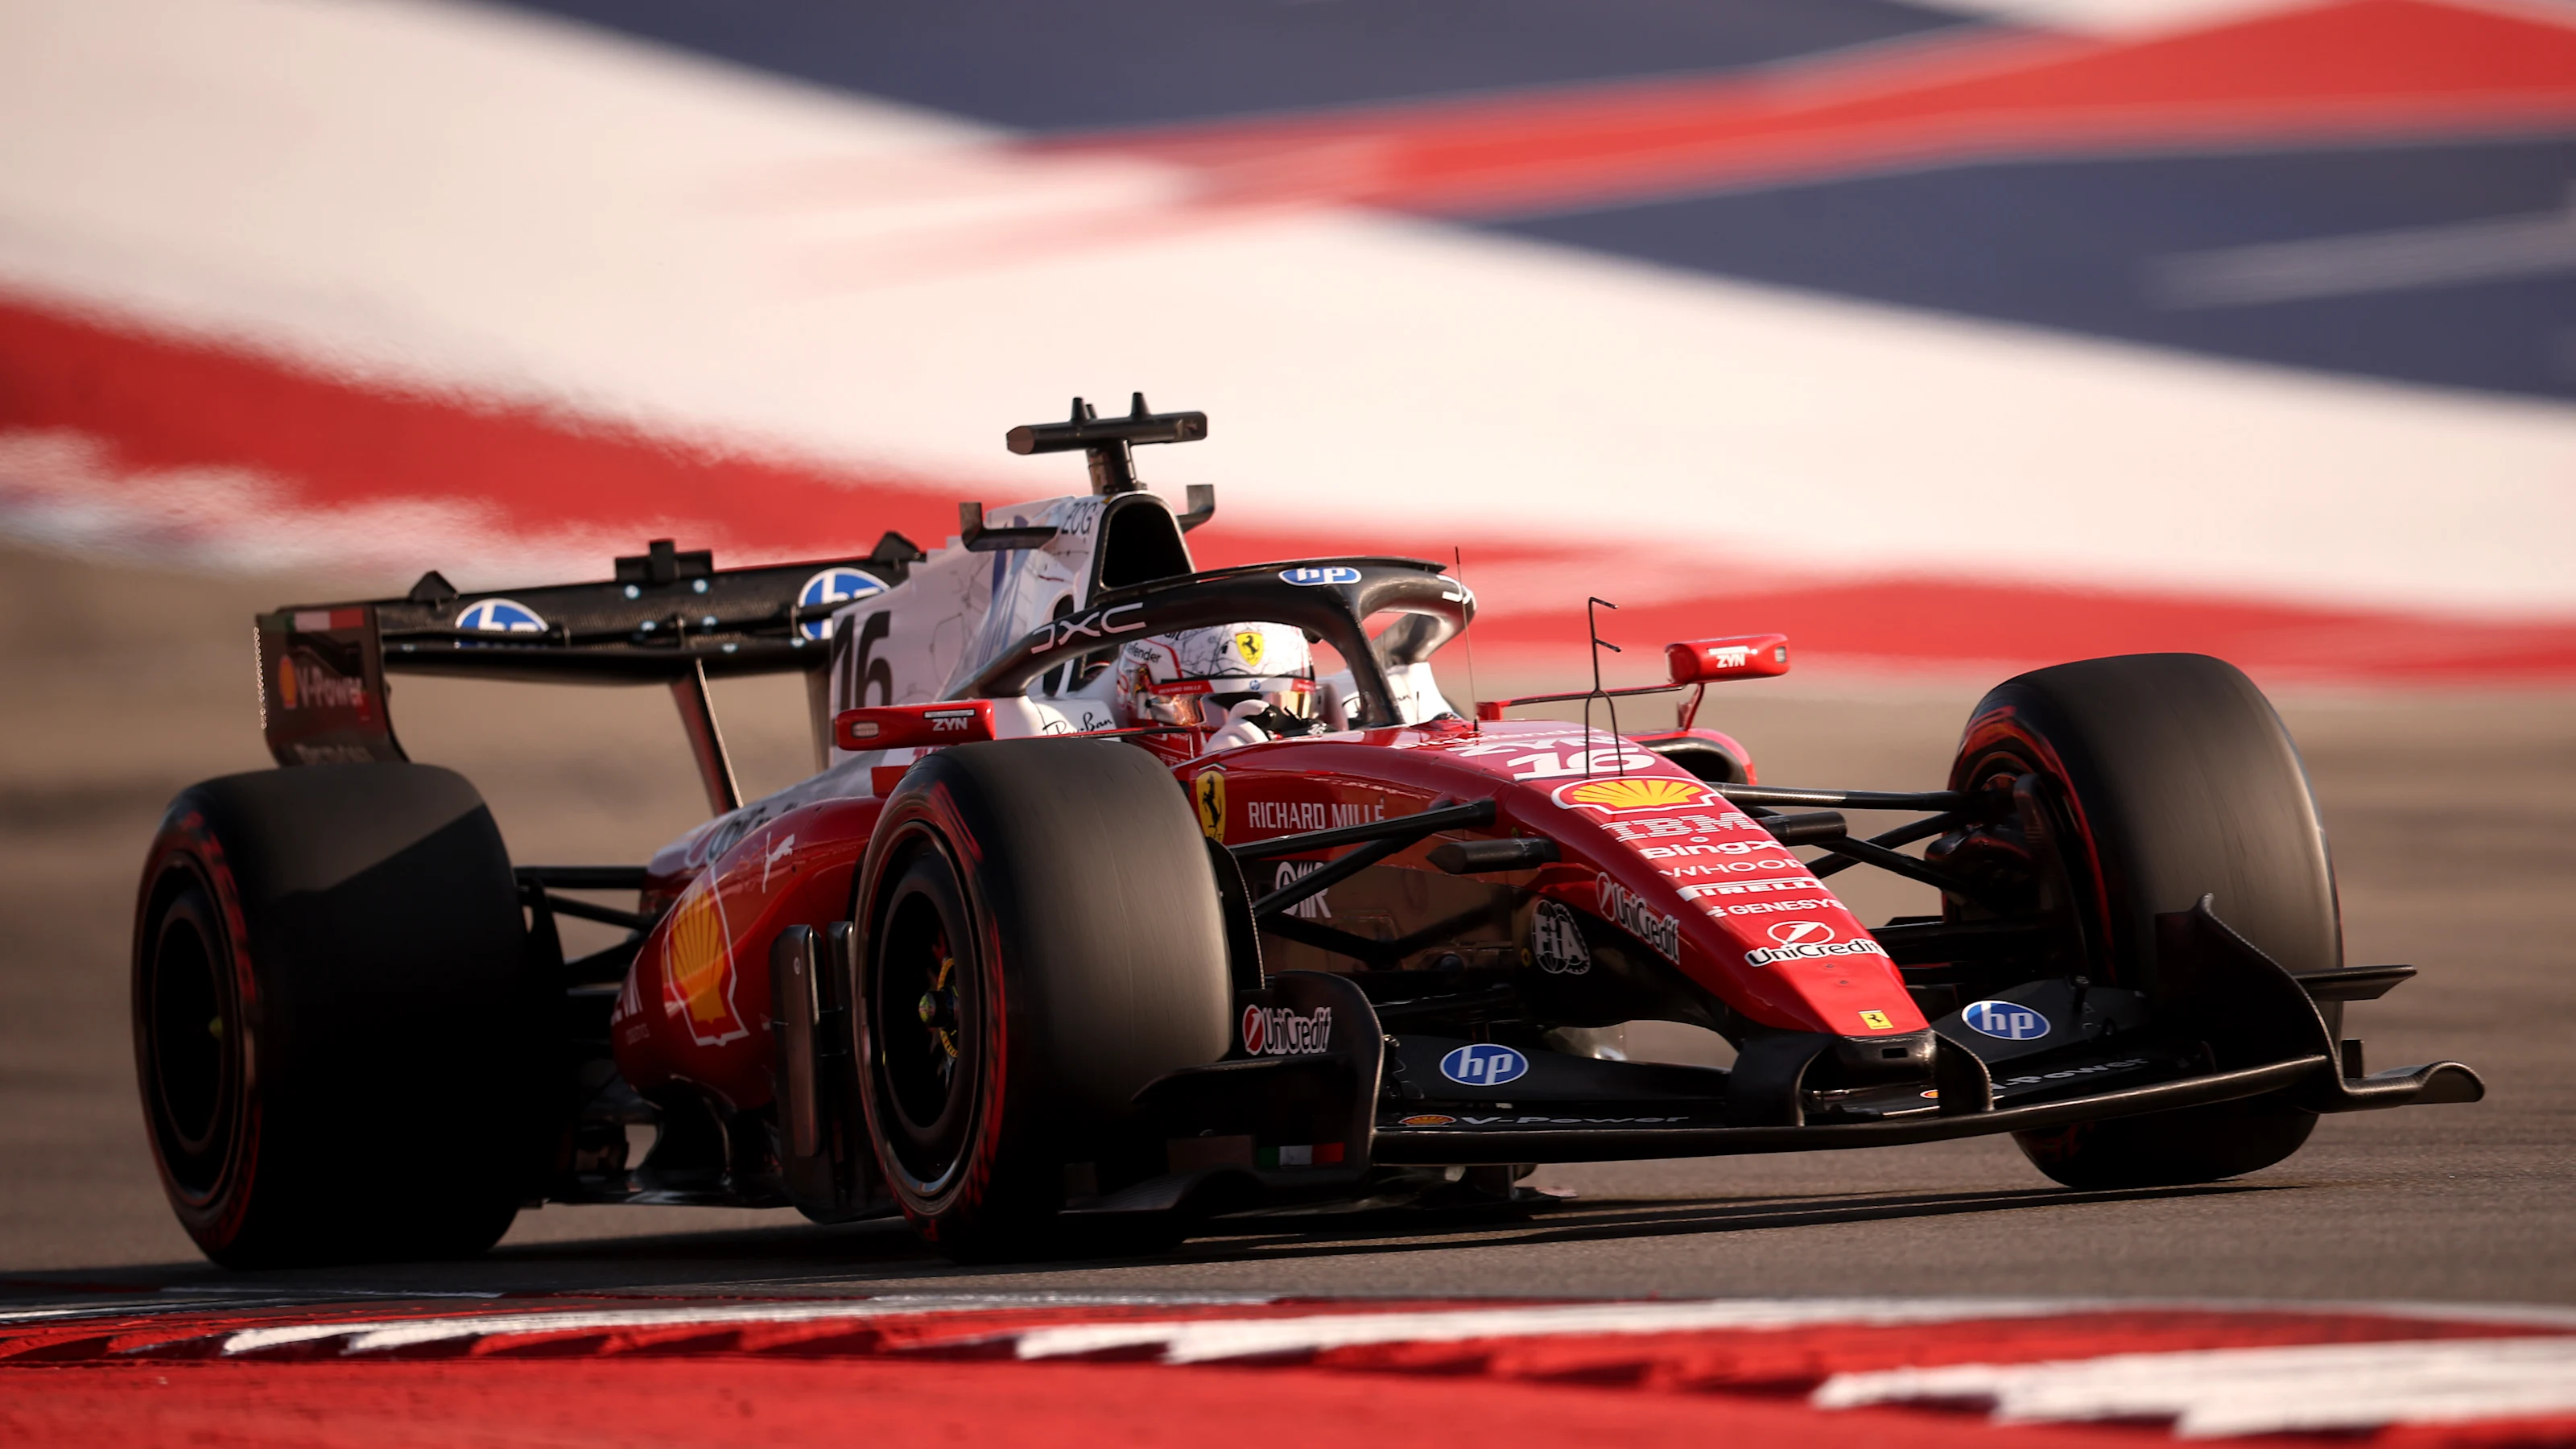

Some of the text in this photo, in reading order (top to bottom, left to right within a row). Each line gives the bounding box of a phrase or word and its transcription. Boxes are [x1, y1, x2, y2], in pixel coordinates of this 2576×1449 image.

[1297, 568, 1347, 584] hp
[832, 610, 893, 710] 16
[1716, 653, 1746, 668] ZYN
[932, 717, 968, 732] ZYN
[1446, 735, 1628, 758] ZYN
[1506, 748, 1656, 781] 16
[1249, 802, 1326, 829] RICHARD
[1599, 812, 1768, 842] IBM
[1659, 858, 1807, 878] WHOOP
[1728, 898, 1848, 915] GENESYS
[1612, 882, 1680, 965] UniCredit
[1746, 939, 1886, 966] UniCredit
[1262, 1007, 1331, 1054] UniCredit
[1981, 1003, 2035, 1040] hp
[1457, 1046, 1514, 1084] hp
[1461, 1116, 1690, 1125] V-Power
